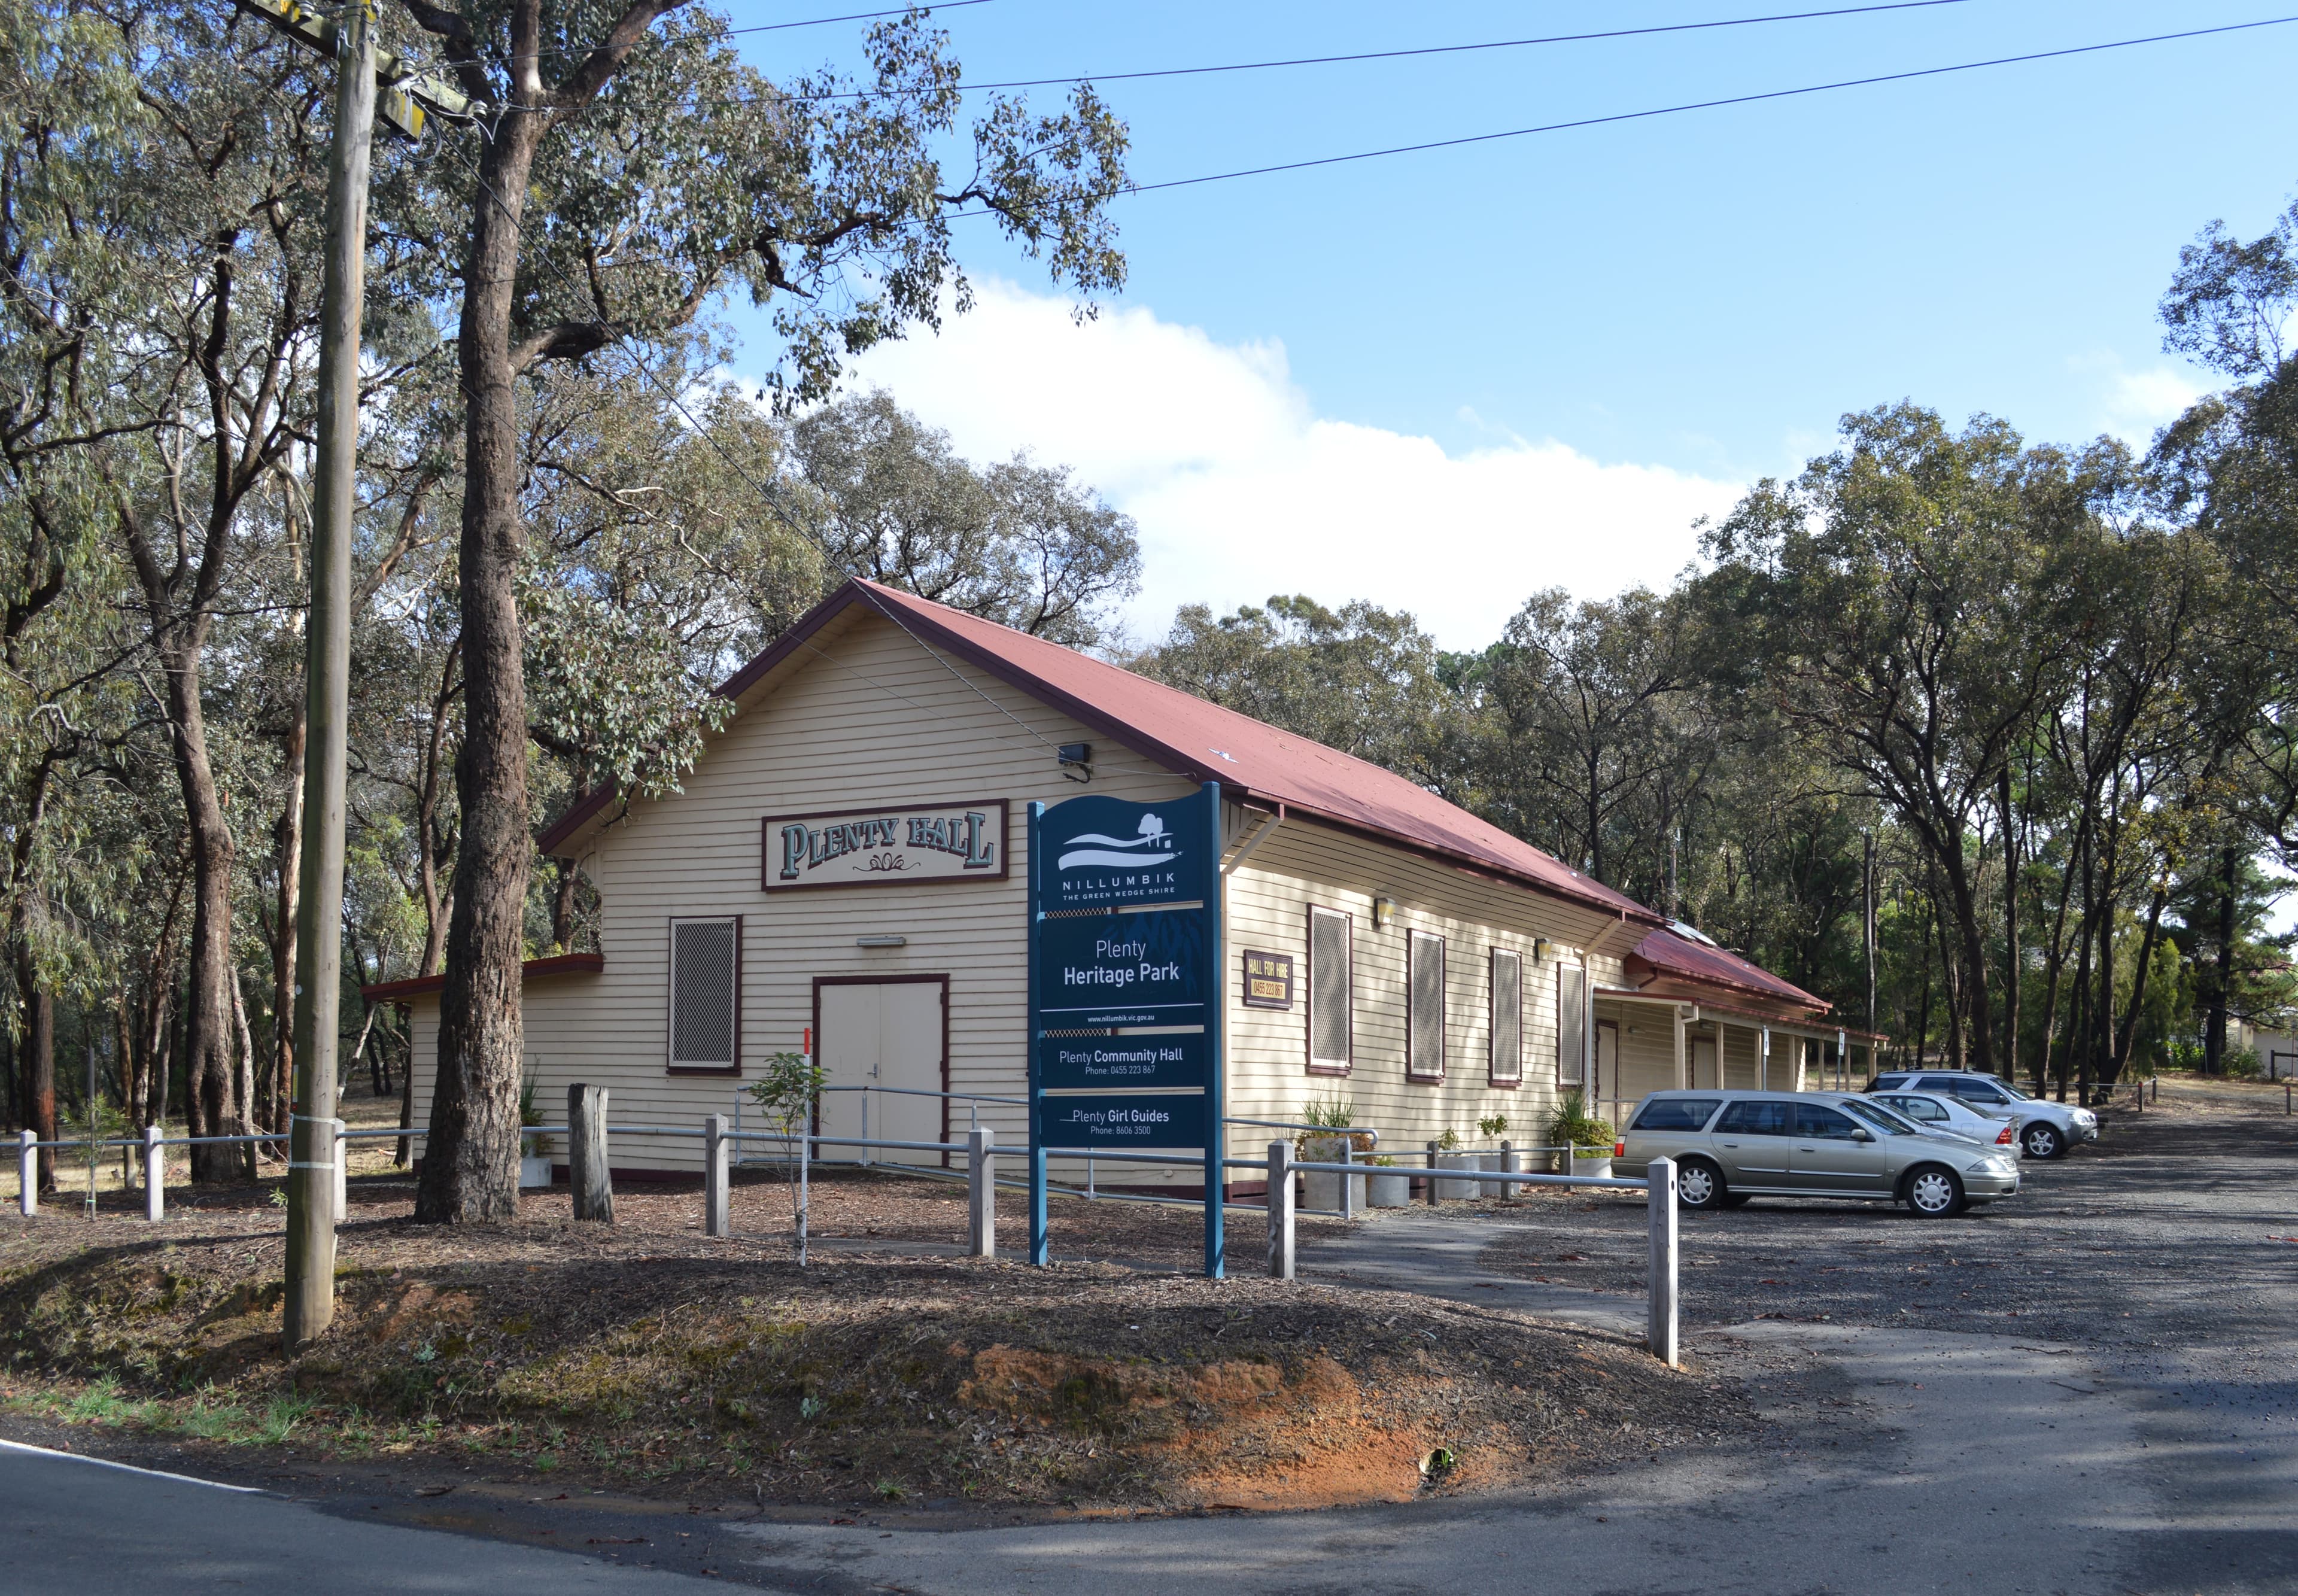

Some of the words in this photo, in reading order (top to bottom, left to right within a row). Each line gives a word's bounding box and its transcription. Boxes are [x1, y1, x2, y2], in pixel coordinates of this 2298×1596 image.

[780, 818, 899, 880] PLENTY
[907, 811, 993, 869] HALL
[1063, 873, 1174, 890] NILLUMBIK
[1096, 940, 1146, 961] Plenty
[1065, 966, 1135, 987] Heritage
[1140, 962, 1180, 981] Park
[1248, 958, 1262, 975] HALL
[1264, 960, 1274, 977] FOR
[1276, 962, 1288, 978] HIRE
[1254, 981, 1265, 994] 0455
[1060, 1051, 1092, 1066] Plenty
[1095, 1049, 1157, 1064] Community
[1160, 1048, 1183, 1060] Hall
[1086, 1066, 1109, 1075] Phone:
[1111, 1066, 1127, 1074] 0455
[1129, 1065, 1141, 1074] 223
[1142, 1065, 1156, 1074] 867
[1073, 1109, 1105, 1125] Plenty
[1108, 1109, 1128, 1122] Girl
[1131, 1109, 1169, 1122] Guides
[1090, 1126, 1114, 1135] Phone:
[1116, 1126, 1132, 1135] 8606
[1134, 1126, 1151, 1135] 3500
